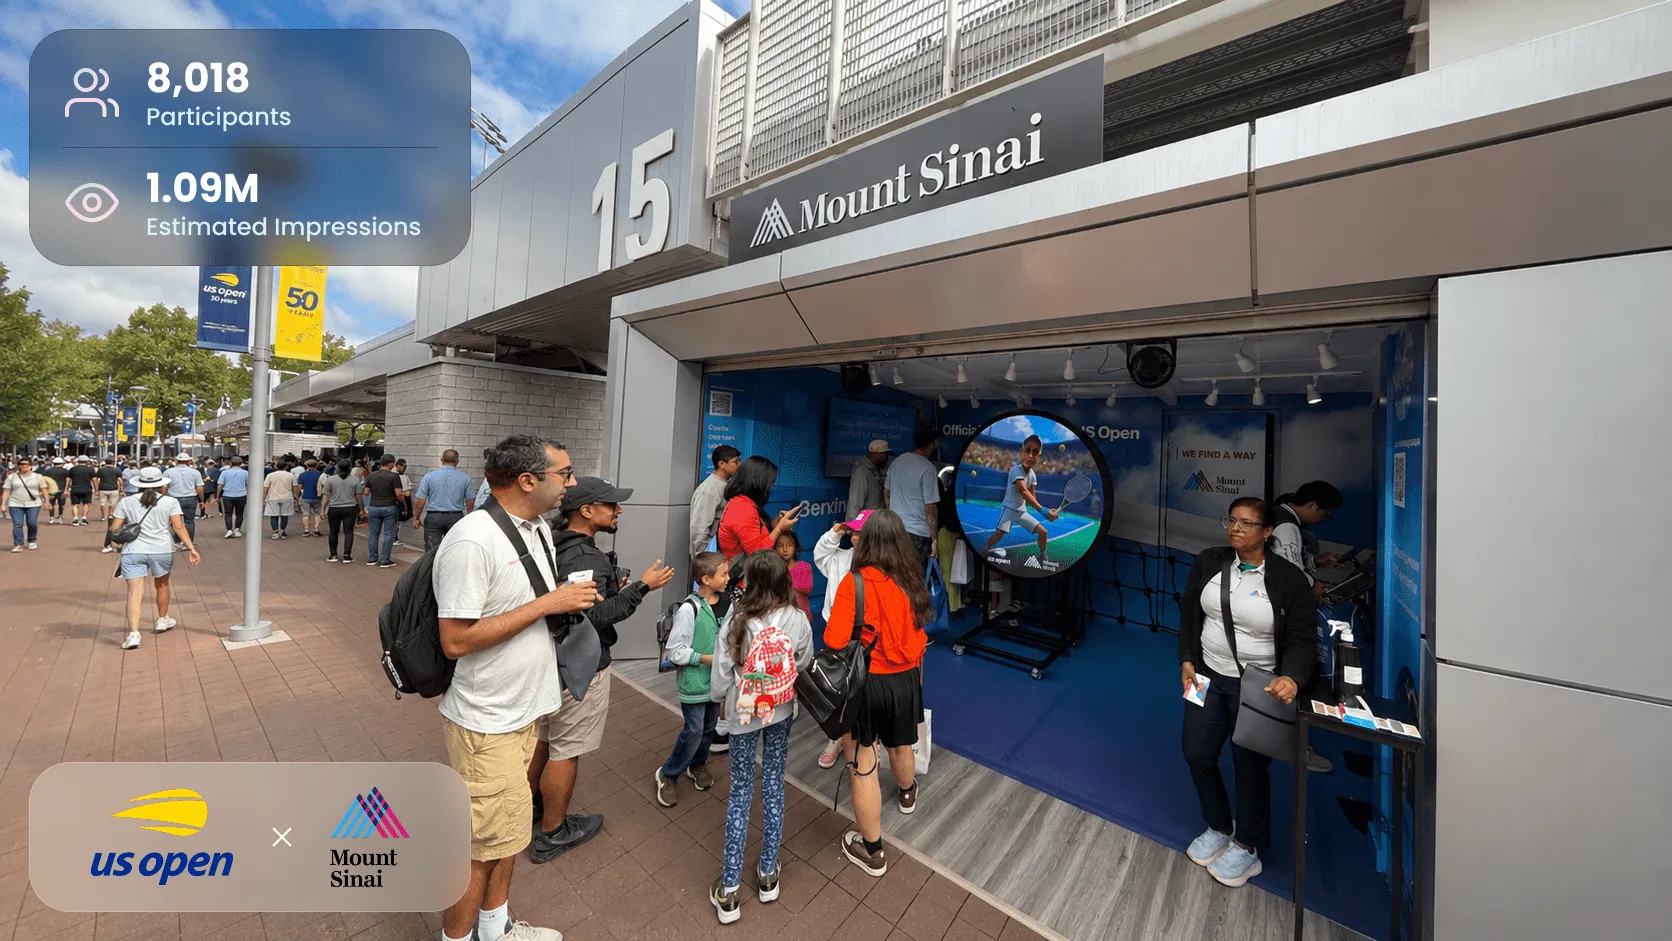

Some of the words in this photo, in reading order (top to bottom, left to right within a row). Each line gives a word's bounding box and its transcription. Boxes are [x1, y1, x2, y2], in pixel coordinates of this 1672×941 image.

[797, 163, 911, 234] Mount
[919, 112, 1045, 198] Sinai
[591, 128, 674, 273] 15
[203, 284, 217, 294] us
[218, 288, 246, 299] open
[285, 286, 319, 312] 50
[1098, 425, 1141, 442] Open
[1181, 449, 1196, 459] WE
[1198, 450, 1221, 460] FIND
[1222, 451, 1231, 460] A
[1232, 451, 1257, 461] WAY
[1216, 476, 1246, 486] Mount
